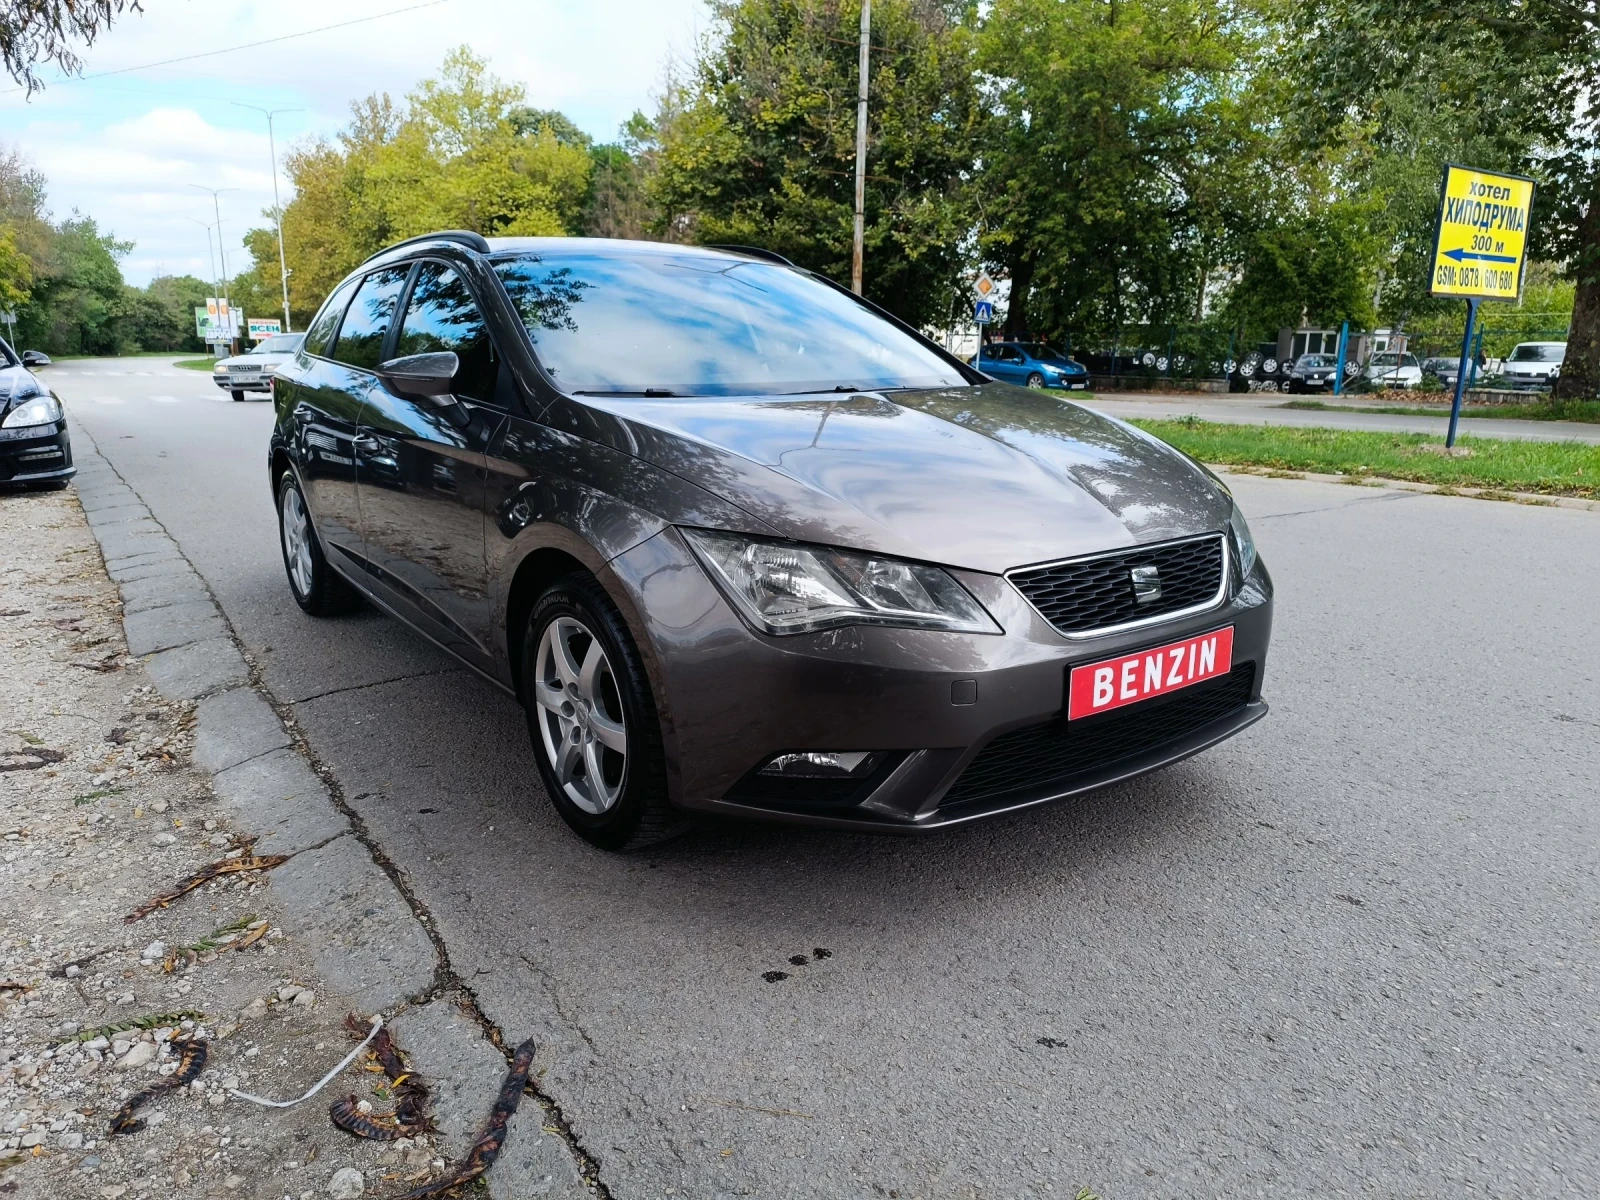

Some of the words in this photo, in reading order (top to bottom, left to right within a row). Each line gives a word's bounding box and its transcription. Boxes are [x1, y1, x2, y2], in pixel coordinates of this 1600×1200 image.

[1469, 181, 1511, 201] хотел
[1444, 196, 1524, 234] ХИПОДРУМА
[1471, 234, 1493, 252] 300
[1436, 264, 1457, 287] GSM:
[1459, 266, 1480, 288] 0878
[1484, 268, 1498, 289] 600
[1499, 269, 1513, 291] 680
[1092, 636, 1218, 708] BENZIN
